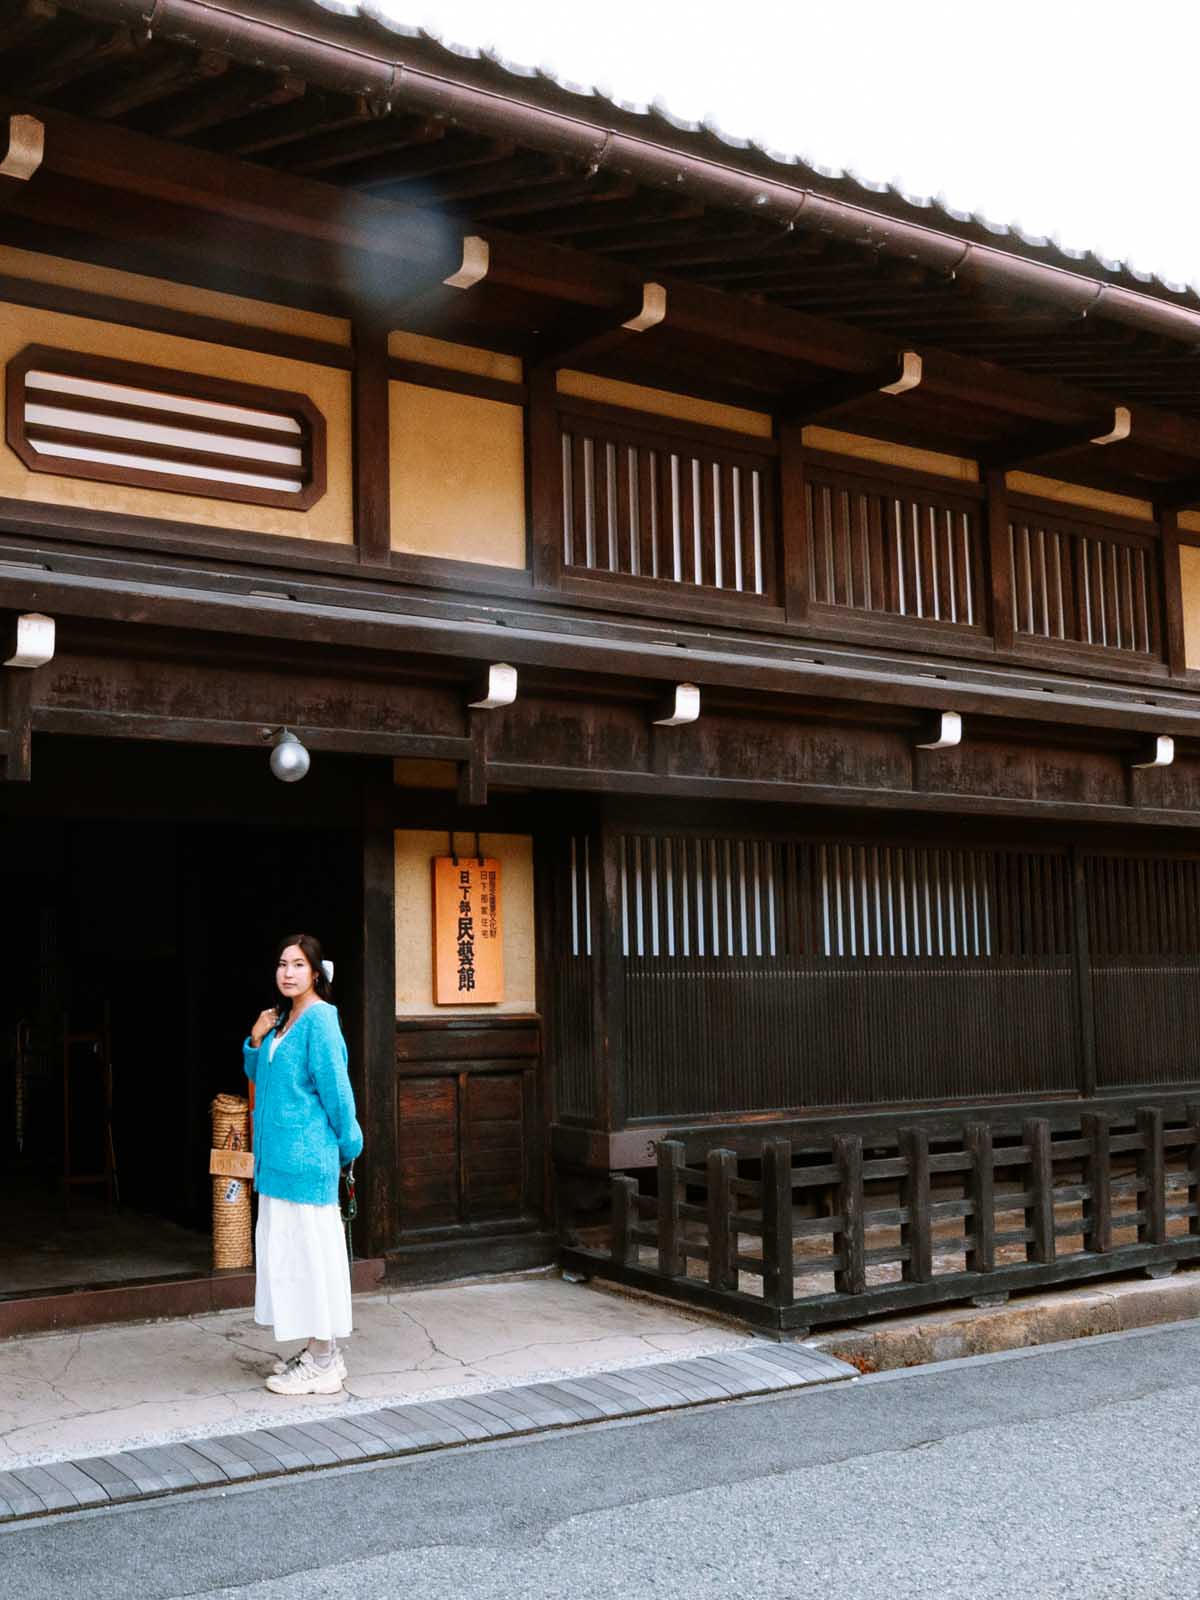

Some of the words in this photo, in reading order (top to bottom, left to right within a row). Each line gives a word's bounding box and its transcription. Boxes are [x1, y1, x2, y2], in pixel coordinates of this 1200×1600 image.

[457, 870, 476, 992] 日下部民藝館
